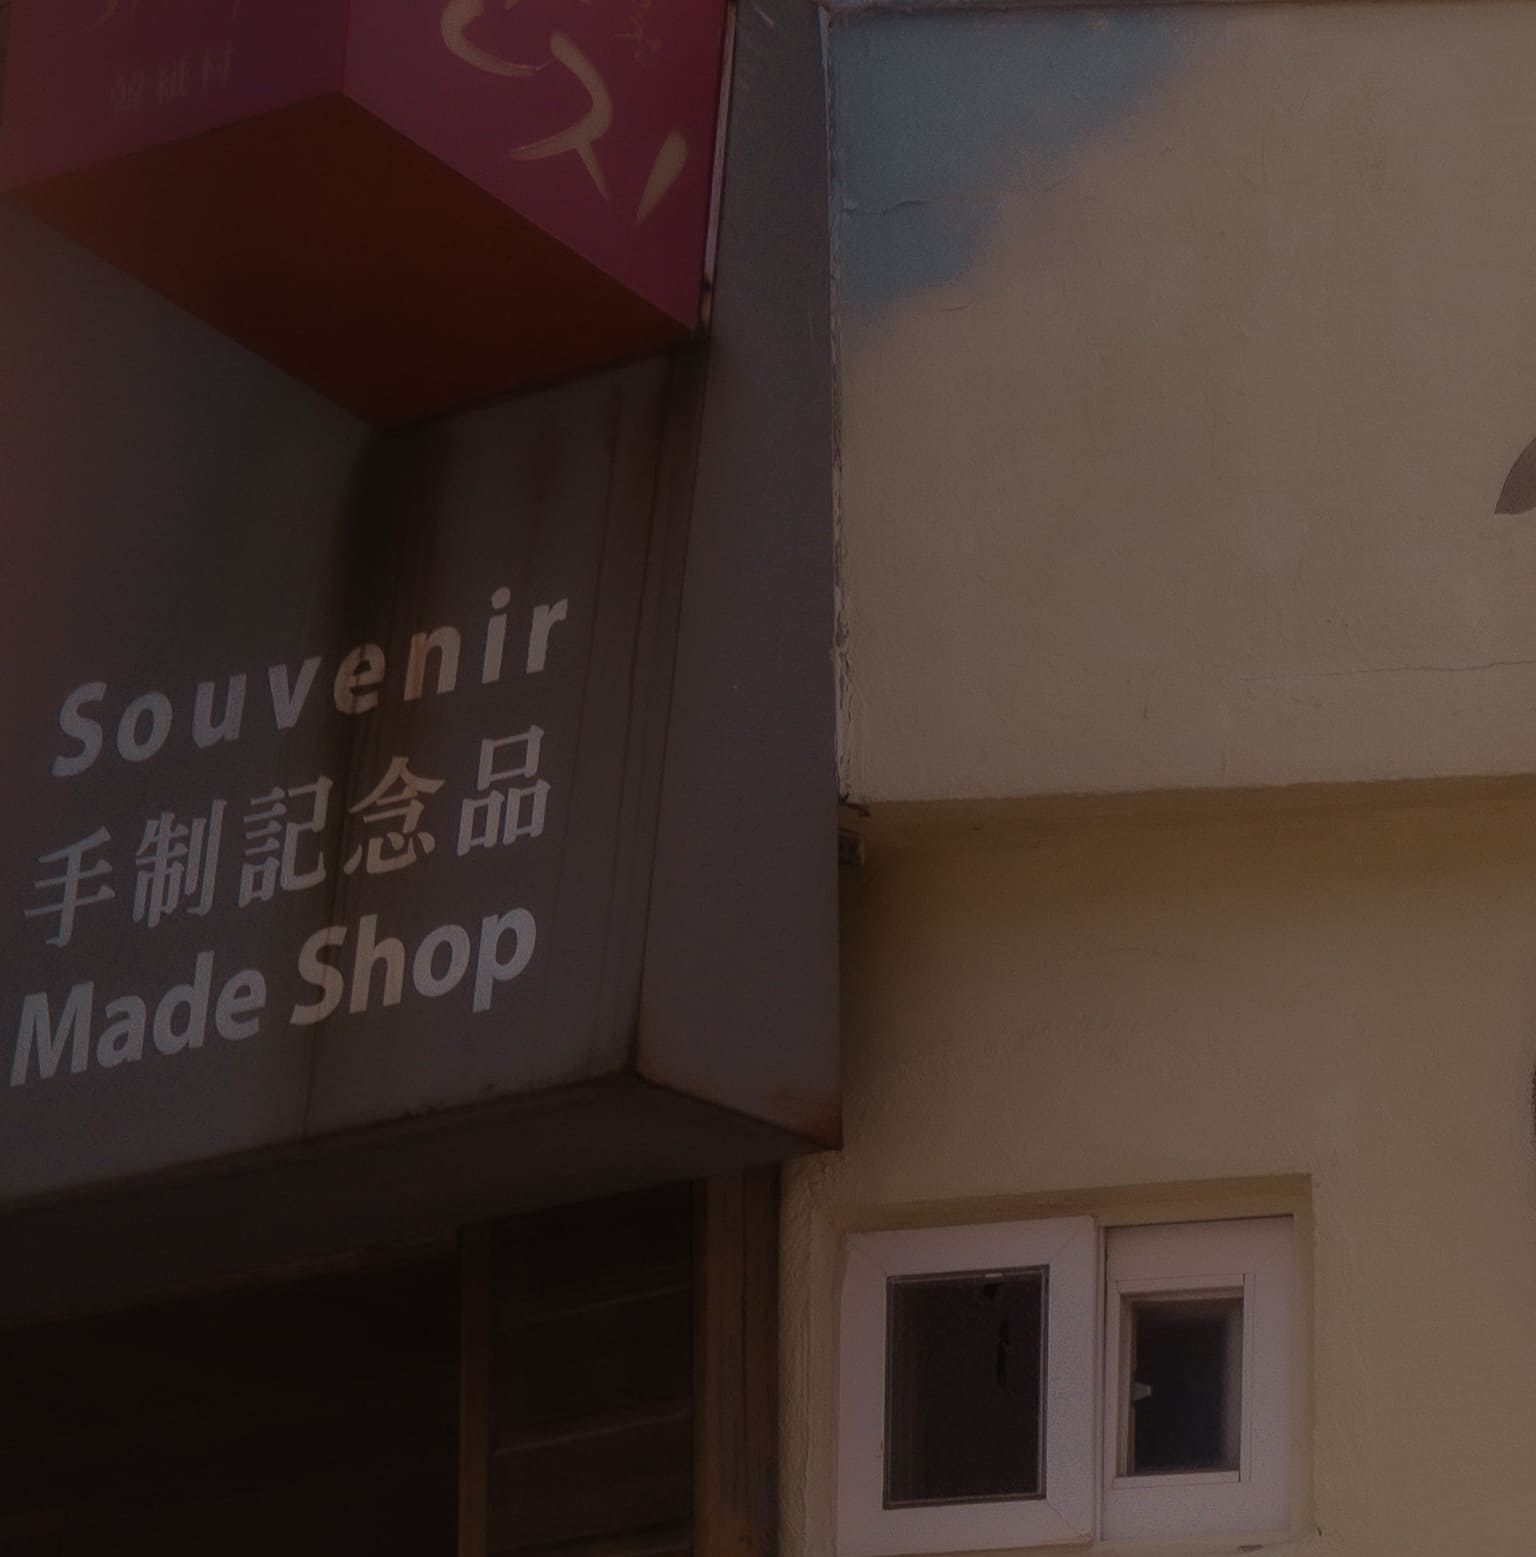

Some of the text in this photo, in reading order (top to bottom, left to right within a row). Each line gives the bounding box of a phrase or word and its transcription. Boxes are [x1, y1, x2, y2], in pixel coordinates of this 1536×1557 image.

[51, 586, 568, 778] Souvenir
[24, 724, 551, 948] 手制記念品
[9, 907, 537, 1088] Made Shop
